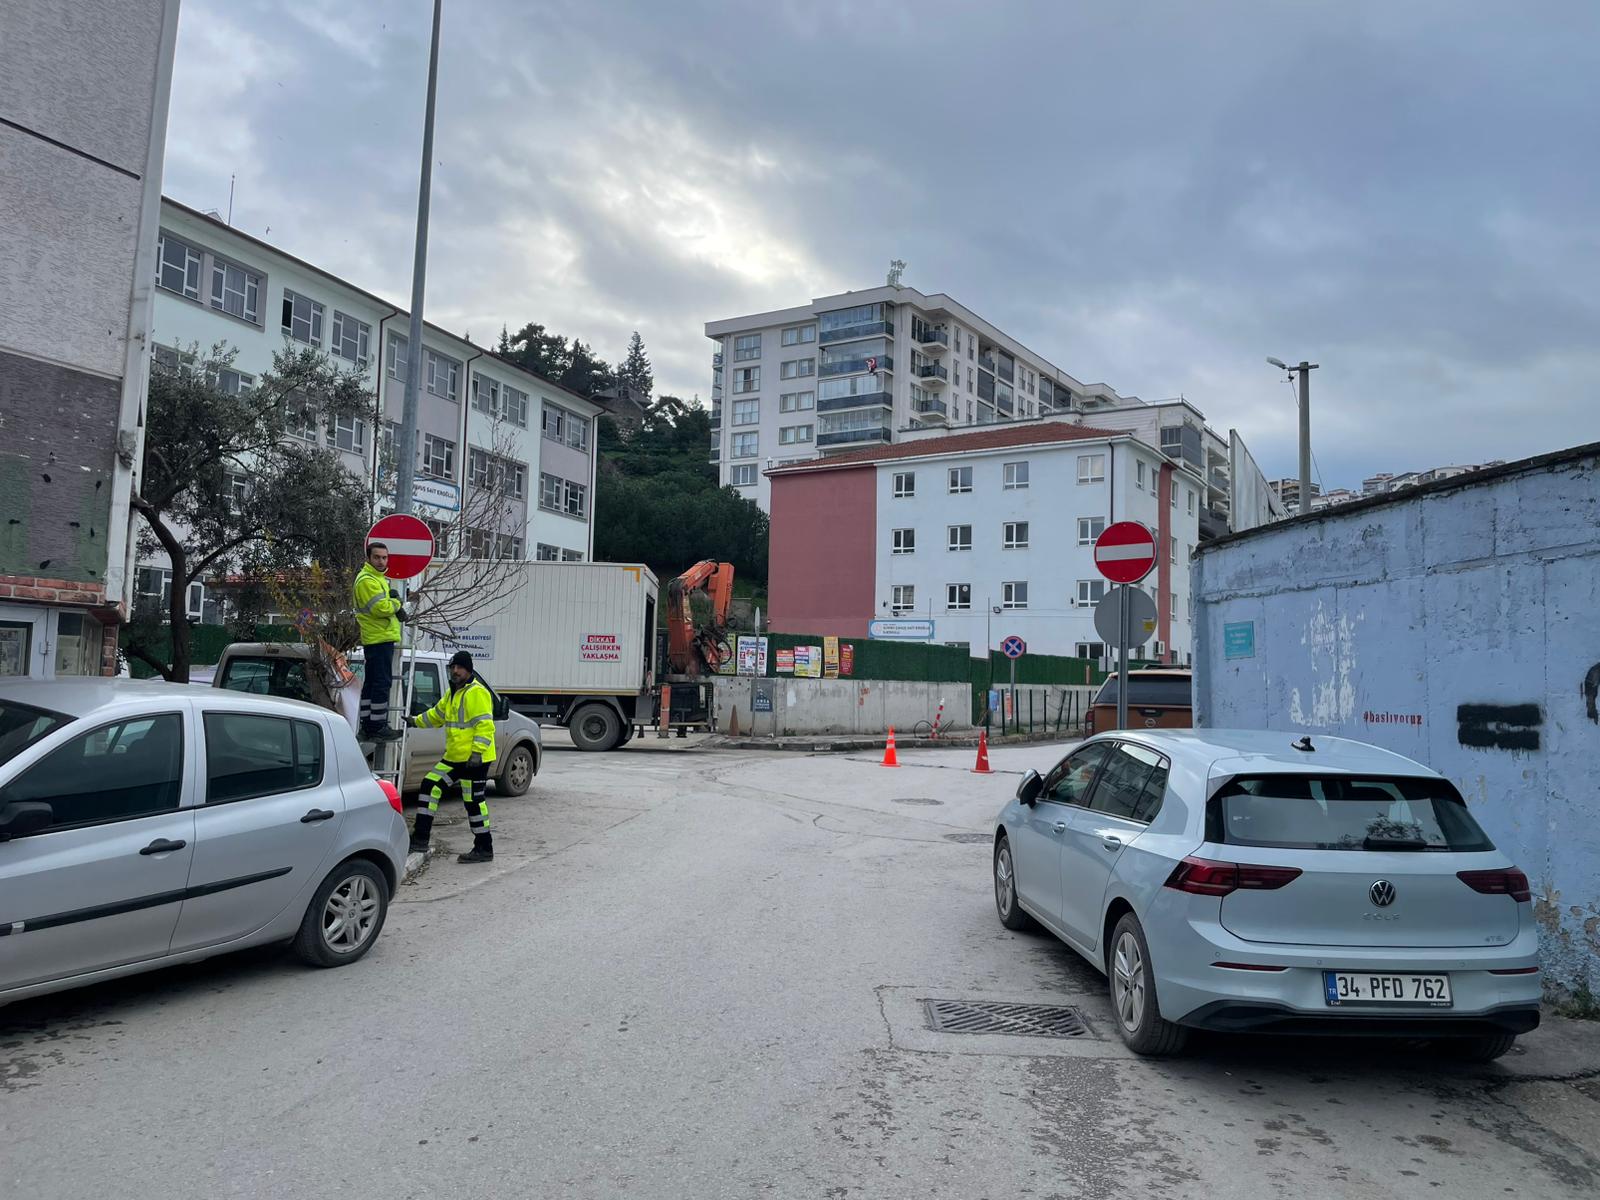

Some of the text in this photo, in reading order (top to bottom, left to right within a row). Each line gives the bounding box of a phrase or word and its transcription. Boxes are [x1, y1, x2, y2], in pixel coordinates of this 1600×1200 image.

[582, 652, 619, 660] YAKLAŞMA
[1329, 987, 1337, 995] TR
[1338, 976, 1446, 999] 34 PFD 762
